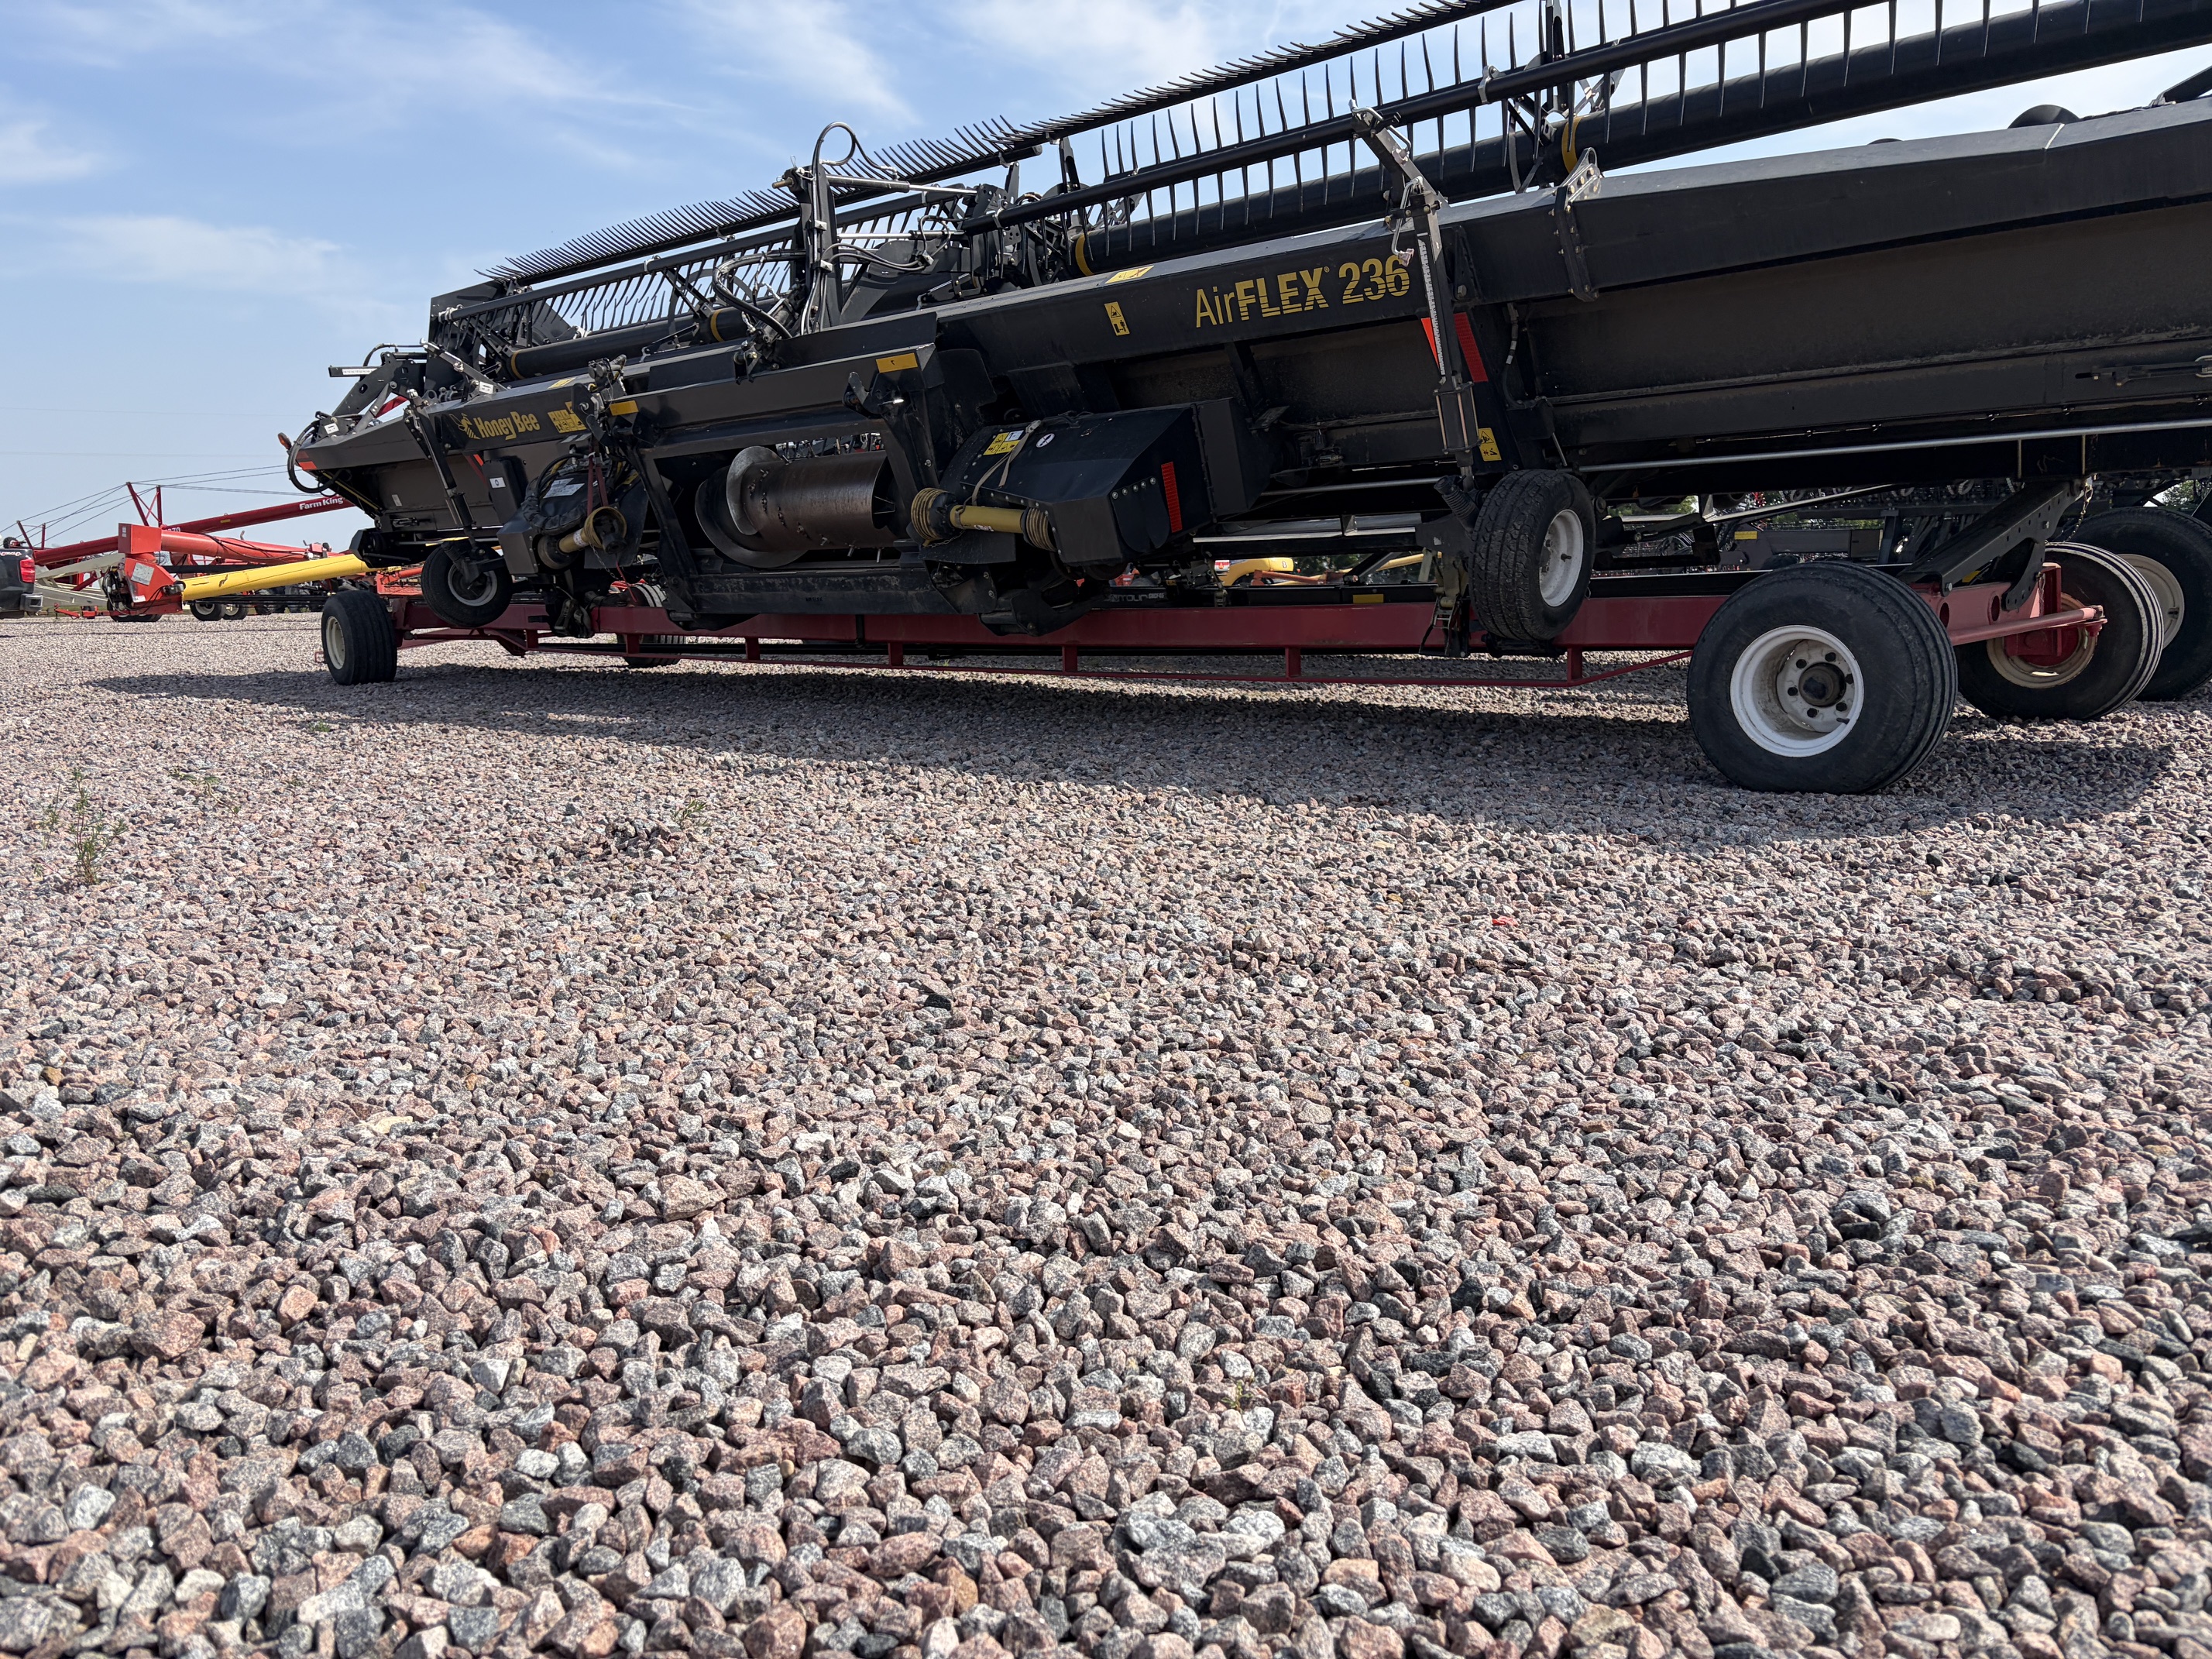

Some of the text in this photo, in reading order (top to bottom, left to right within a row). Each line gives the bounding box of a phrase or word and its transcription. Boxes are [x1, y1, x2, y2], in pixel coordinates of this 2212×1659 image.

[1338, 256, 1410, 304] 236
[299, 497, 343, 510] Farm King
